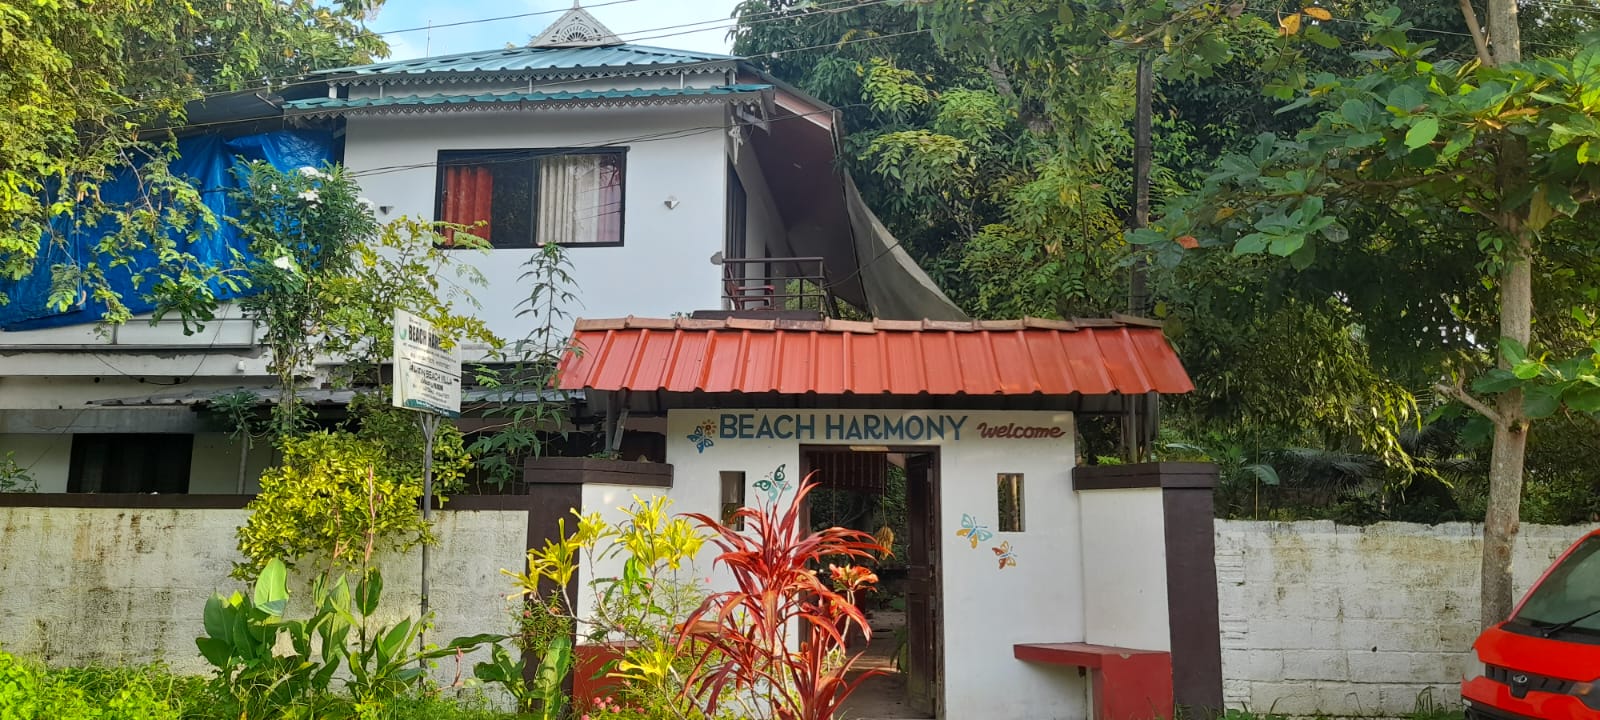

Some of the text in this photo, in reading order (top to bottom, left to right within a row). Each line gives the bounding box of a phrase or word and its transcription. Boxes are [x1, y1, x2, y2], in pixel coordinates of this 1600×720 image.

[408, 324, 427, 345] BEACH
[720, 413, 968, 440] BEACH HARMONY
